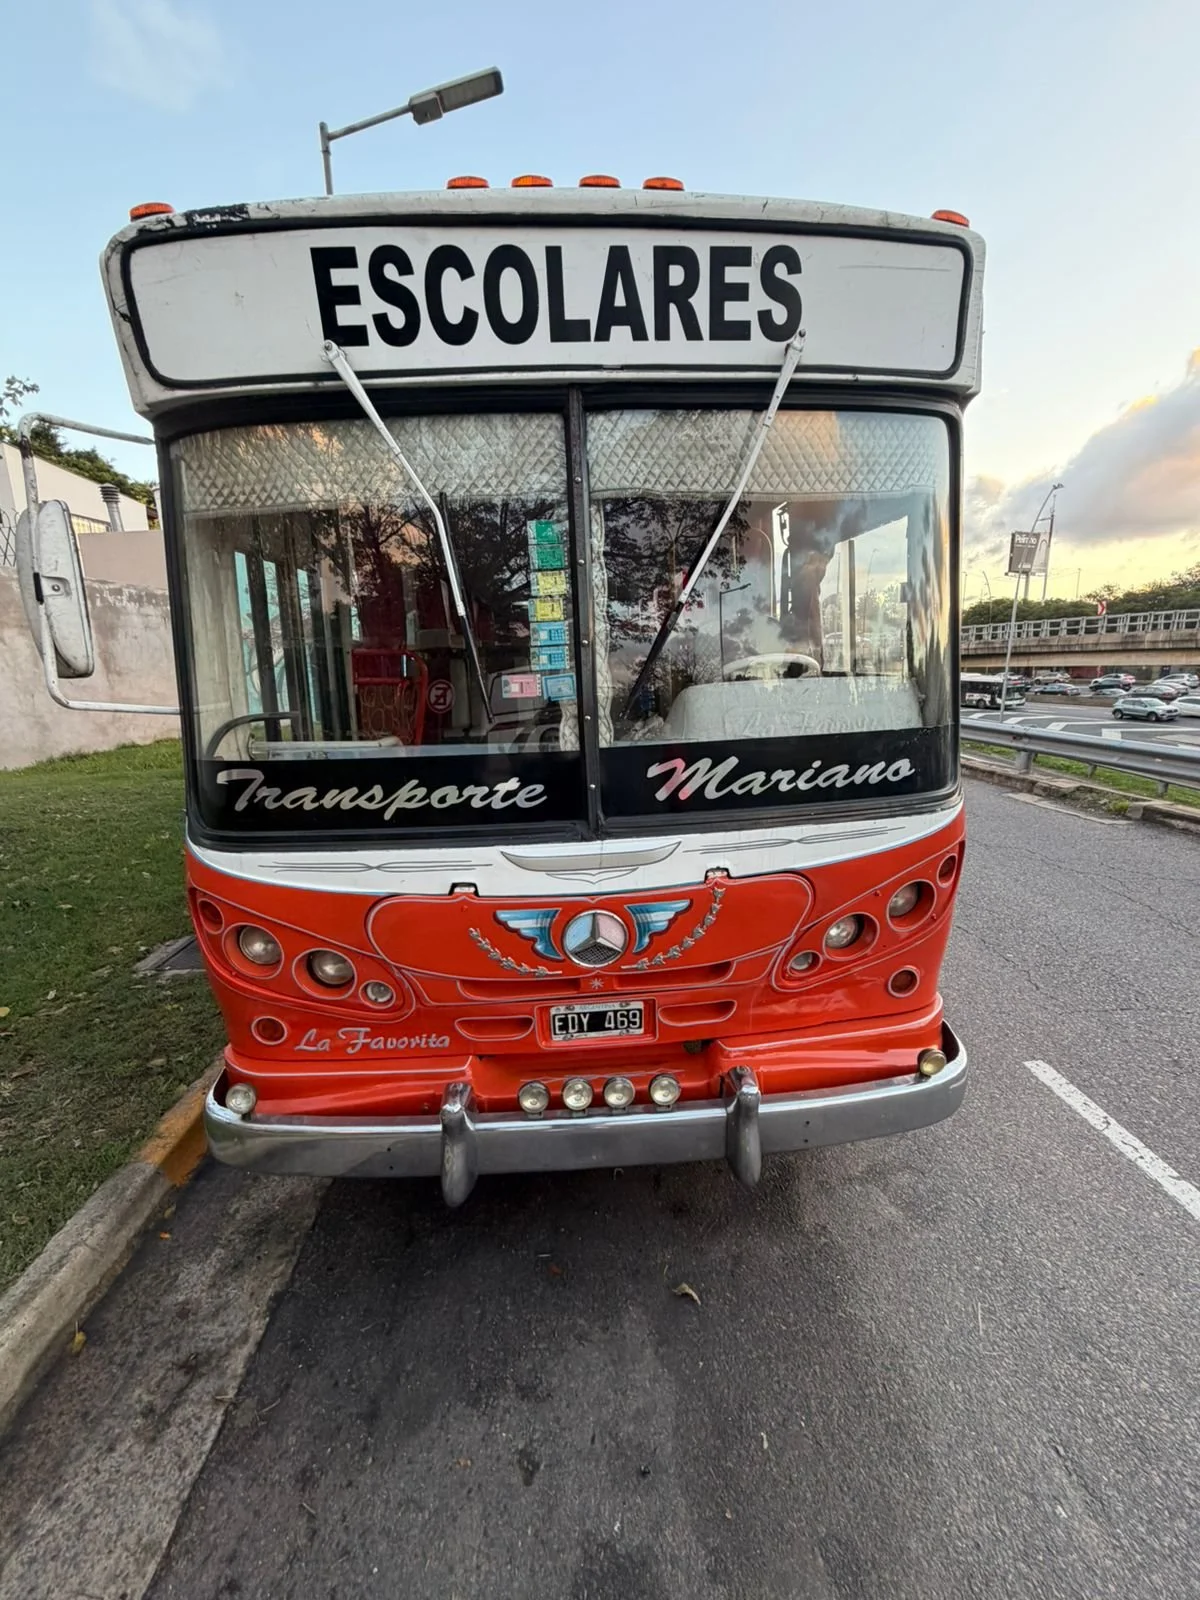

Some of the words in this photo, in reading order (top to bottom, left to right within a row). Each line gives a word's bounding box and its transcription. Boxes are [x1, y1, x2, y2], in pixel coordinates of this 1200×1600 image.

[310, 244, 803, 346] ESCOLARES
[216, 769, 547, 820] Transporte
[647, 756, 915, 801] Mariano
[294, 1028, 331, 1051] La
[337, 1027, 450, 1054] Favorita
[554, 1013, 590, 1034] EDY
[604, 1010, 640, 1029] 469
